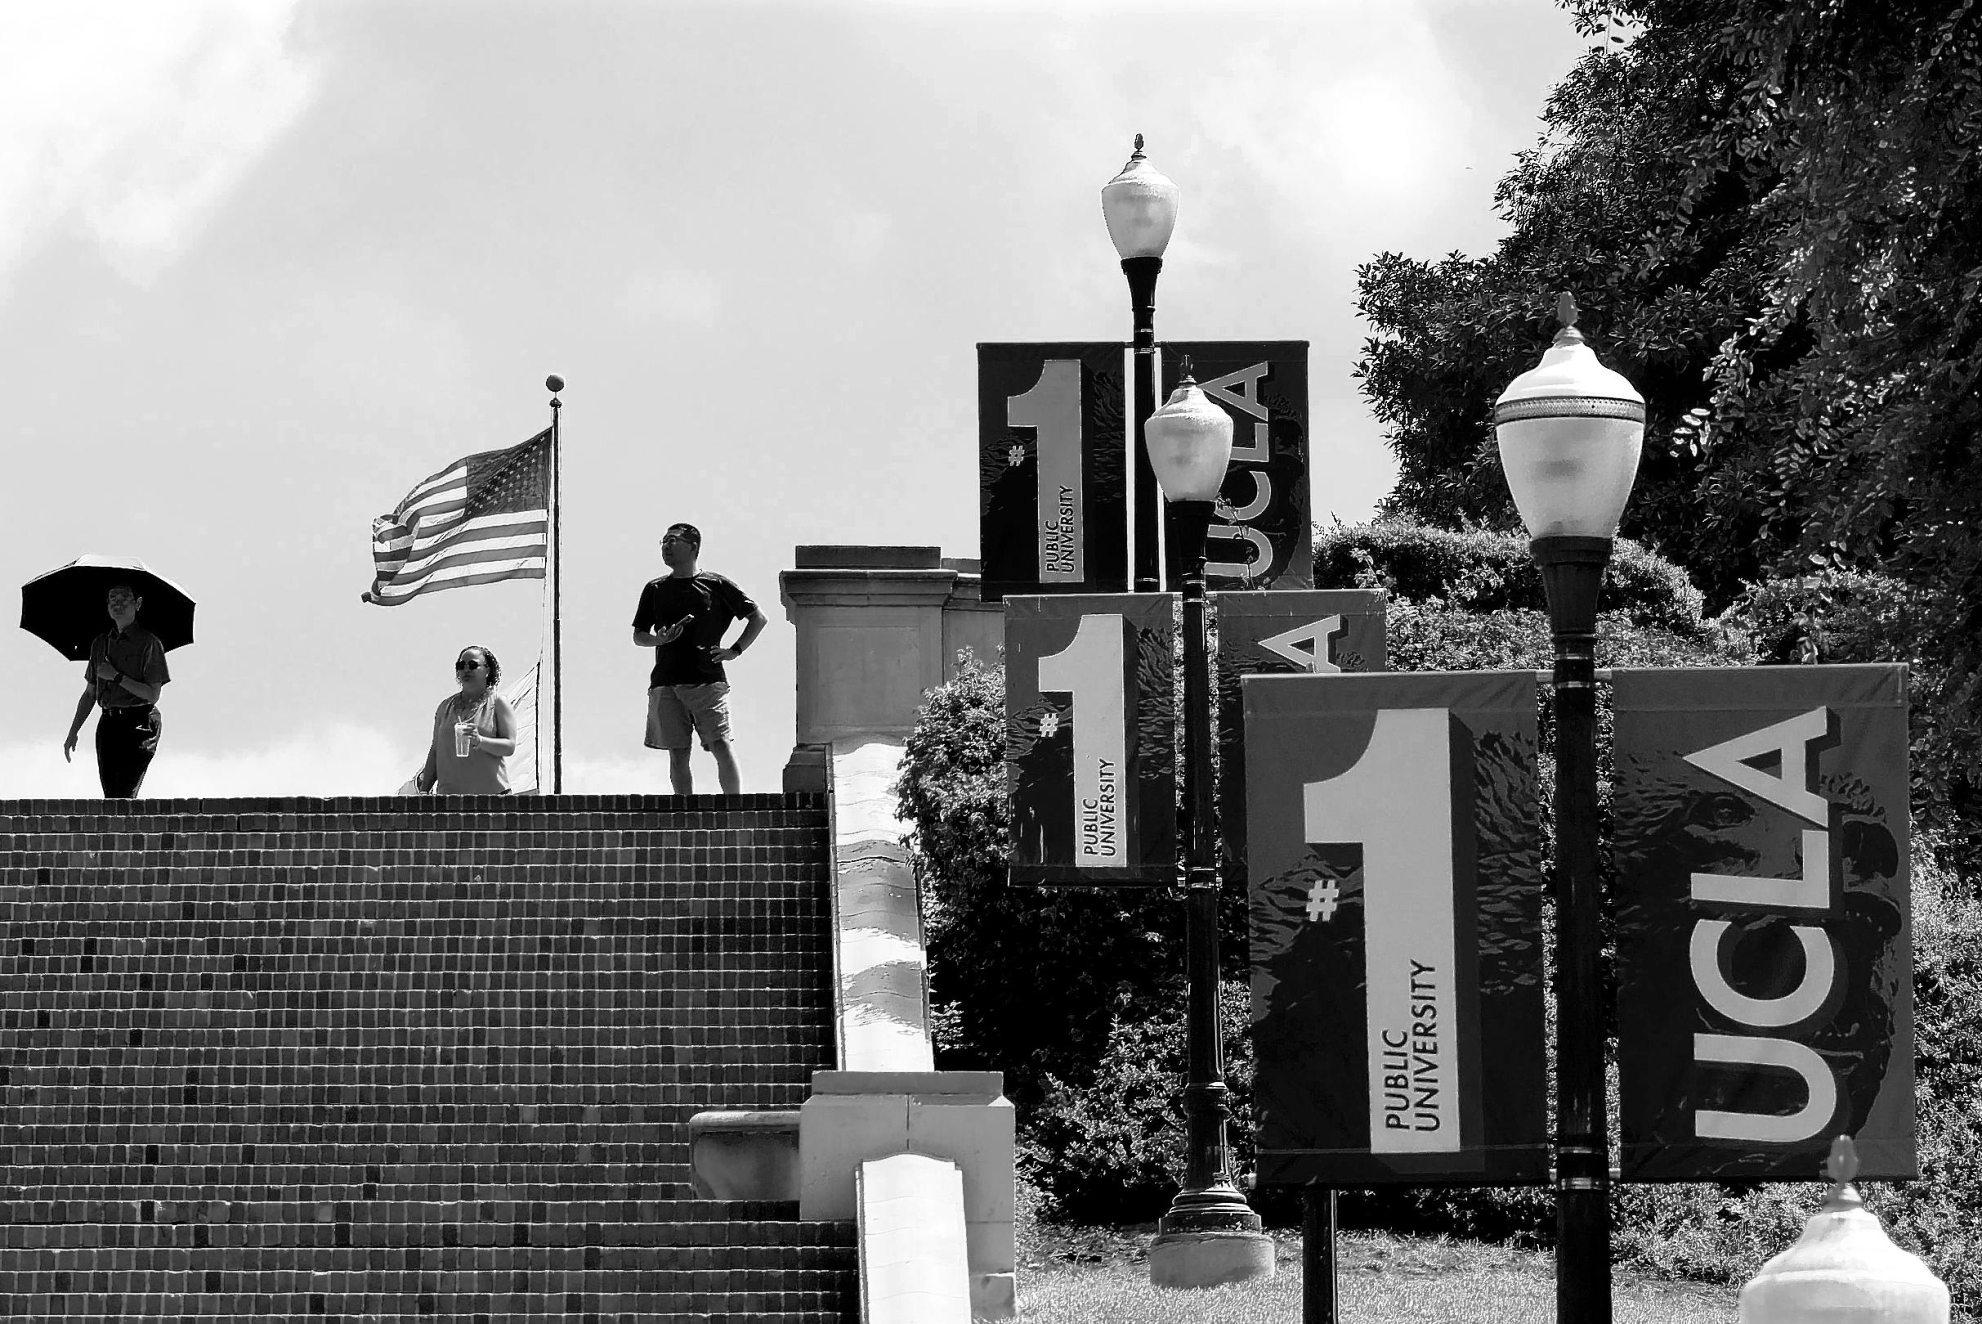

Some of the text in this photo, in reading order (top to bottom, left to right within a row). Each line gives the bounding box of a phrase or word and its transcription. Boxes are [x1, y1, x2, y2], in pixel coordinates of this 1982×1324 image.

[1046, 520, 1060, 574] PUBLIC
[1060, 485, 1075, 574] UNIVERSITY
[1082, 798, 1099, 857] PUBLIC
[1099, 758, 1116, 858] UNIVERSITY
[1682, 705, 1837, 1143] UCLA
[1383, 1028, 1411, 1131] PUBLIC
[1411, 957, 1438, 1133] UNIVERSITY
